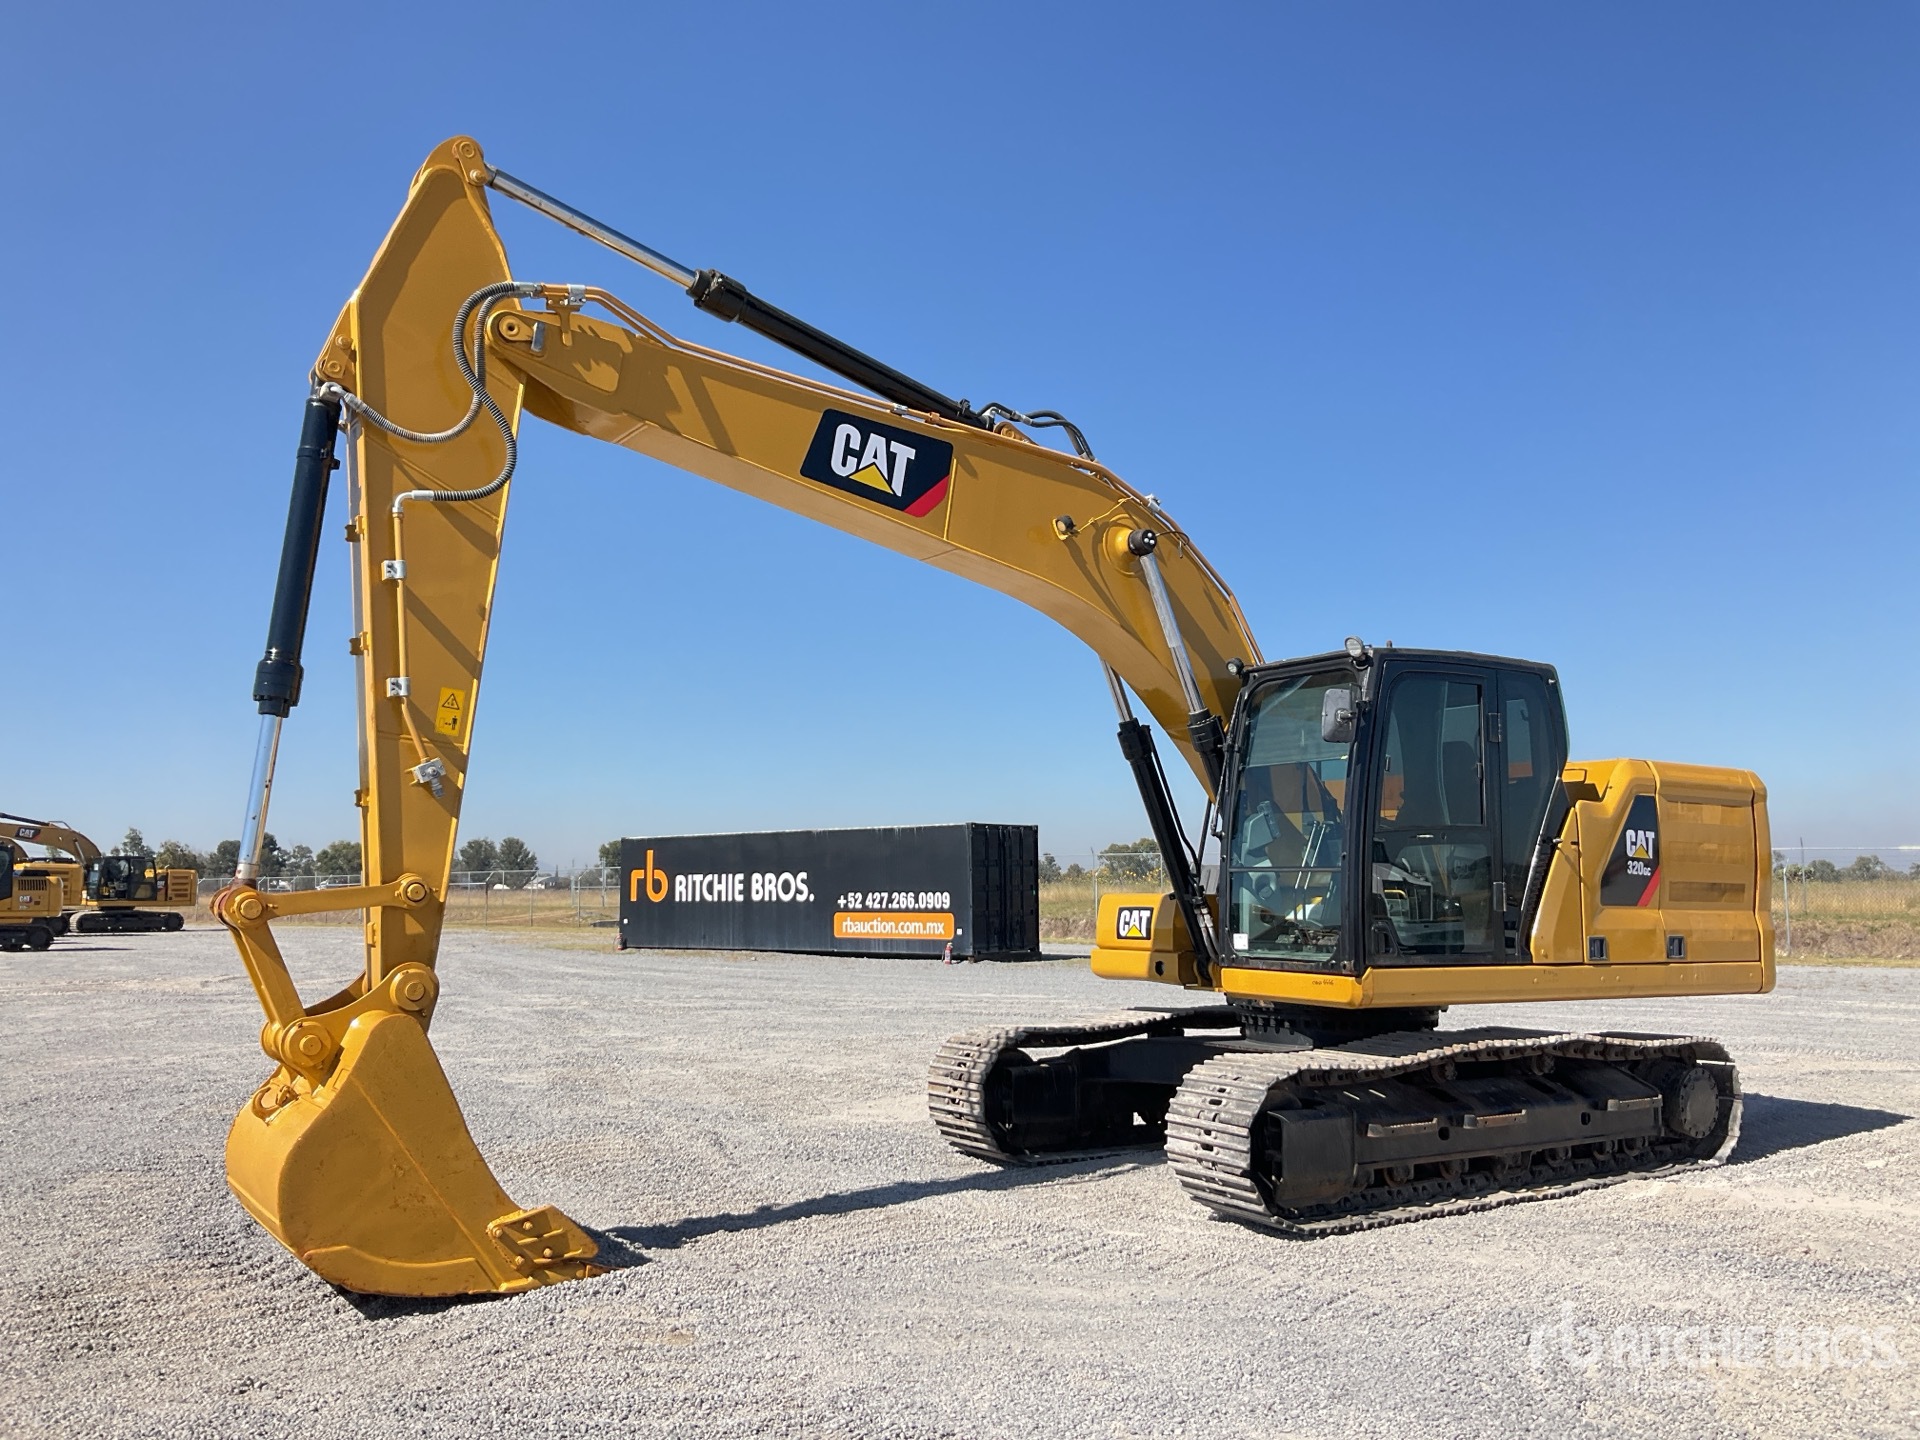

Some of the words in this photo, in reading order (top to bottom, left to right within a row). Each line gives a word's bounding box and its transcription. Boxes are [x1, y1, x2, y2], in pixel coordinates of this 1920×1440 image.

[830, 423, 916, 497] CAT
[19, 828, 35, 838] CAT
[1626, 829, 1655, 859] CAT
[674, 873, 745, 902] RITCHIE
[751, 871, 815, 902] BROS.
[837, 892, 863, 909] +52
[865, 891, 951, 909] 427.266.0909
[842, 916, 945, 936] rbauction.com.mx
[1119, 909, 1151, 938] CAT
